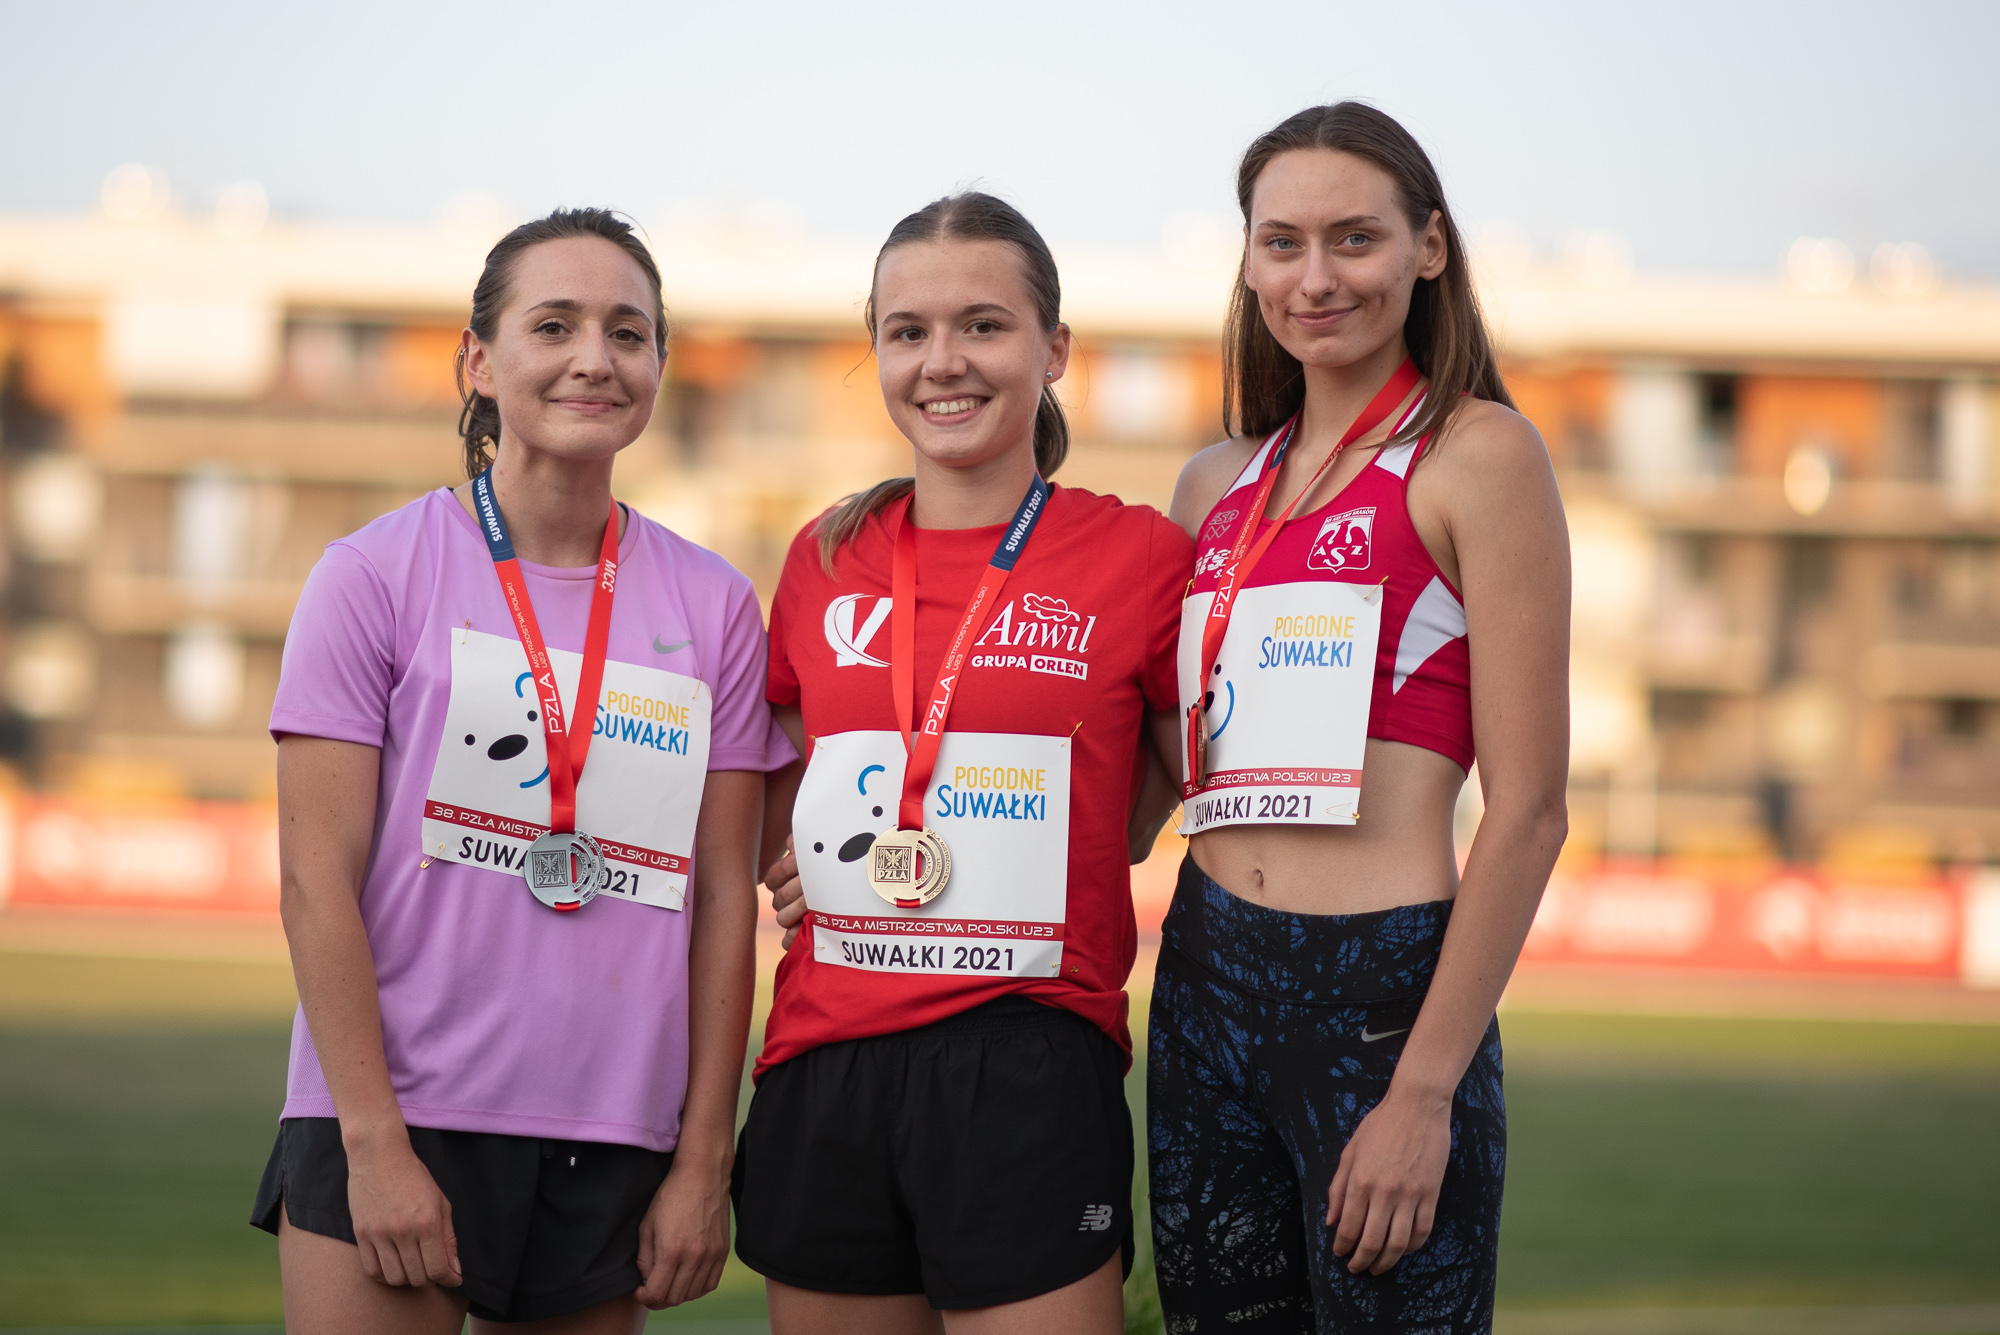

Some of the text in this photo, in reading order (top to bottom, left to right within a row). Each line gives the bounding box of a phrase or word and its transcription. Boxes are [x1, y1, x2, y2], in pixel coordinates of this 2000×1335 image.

[480, 495, 503, 541] SUWAŁKI
[1005, 489, 1043, 552] SUWAŁKI 2021
[602, 559, 617, 593] MCC
[1212, 562, 1240, 618] PZLA
[506, 582, 541, 669] MISTRZOSTWA POLSKI
[945, 586, 988, 670] MISTRZOSTWA POLSKI
[974, 600, 1097, 654] Anwil
[1274, 615, 1356, 639] POGODNE
[538, 651, 548, 669] U23
[952, 653, 964, 671] U23
[971, 655, 1084, 677] GRUPA ORLEN
[1258, 635, 1353, 669] SUWAŁKI
[539, 672, 563, 734] PZLA
[607, 690, 690, 729] POGODNE
[924, 675, 956, 736] PZLA
[592, 704, 689, 756] SUWAŁKI
[954, 766, 1046, 791] POGODNE
[1272, 772, 1318, 783] POLSKI
[1321, 774, 1352, 783] U23
[432, 805, 456, 820] 38.
[459, 812, 495, 829] PZLA
[936, 784, 1046, 821] SUWAŁKI
[1195, 794, 1312, 828] SUWAŁKI 2021
[600, 843, 680, 869] POLSKI U23
[536, 874, 565, 885] PZLA
[877, 870, 908, 880] PZLA
[814, 914, 1054, 937] 38. PZLA MISTRZOSTWA POLSKI U23
[841, 940, 1014, 971] SUWAŁKI 2021
